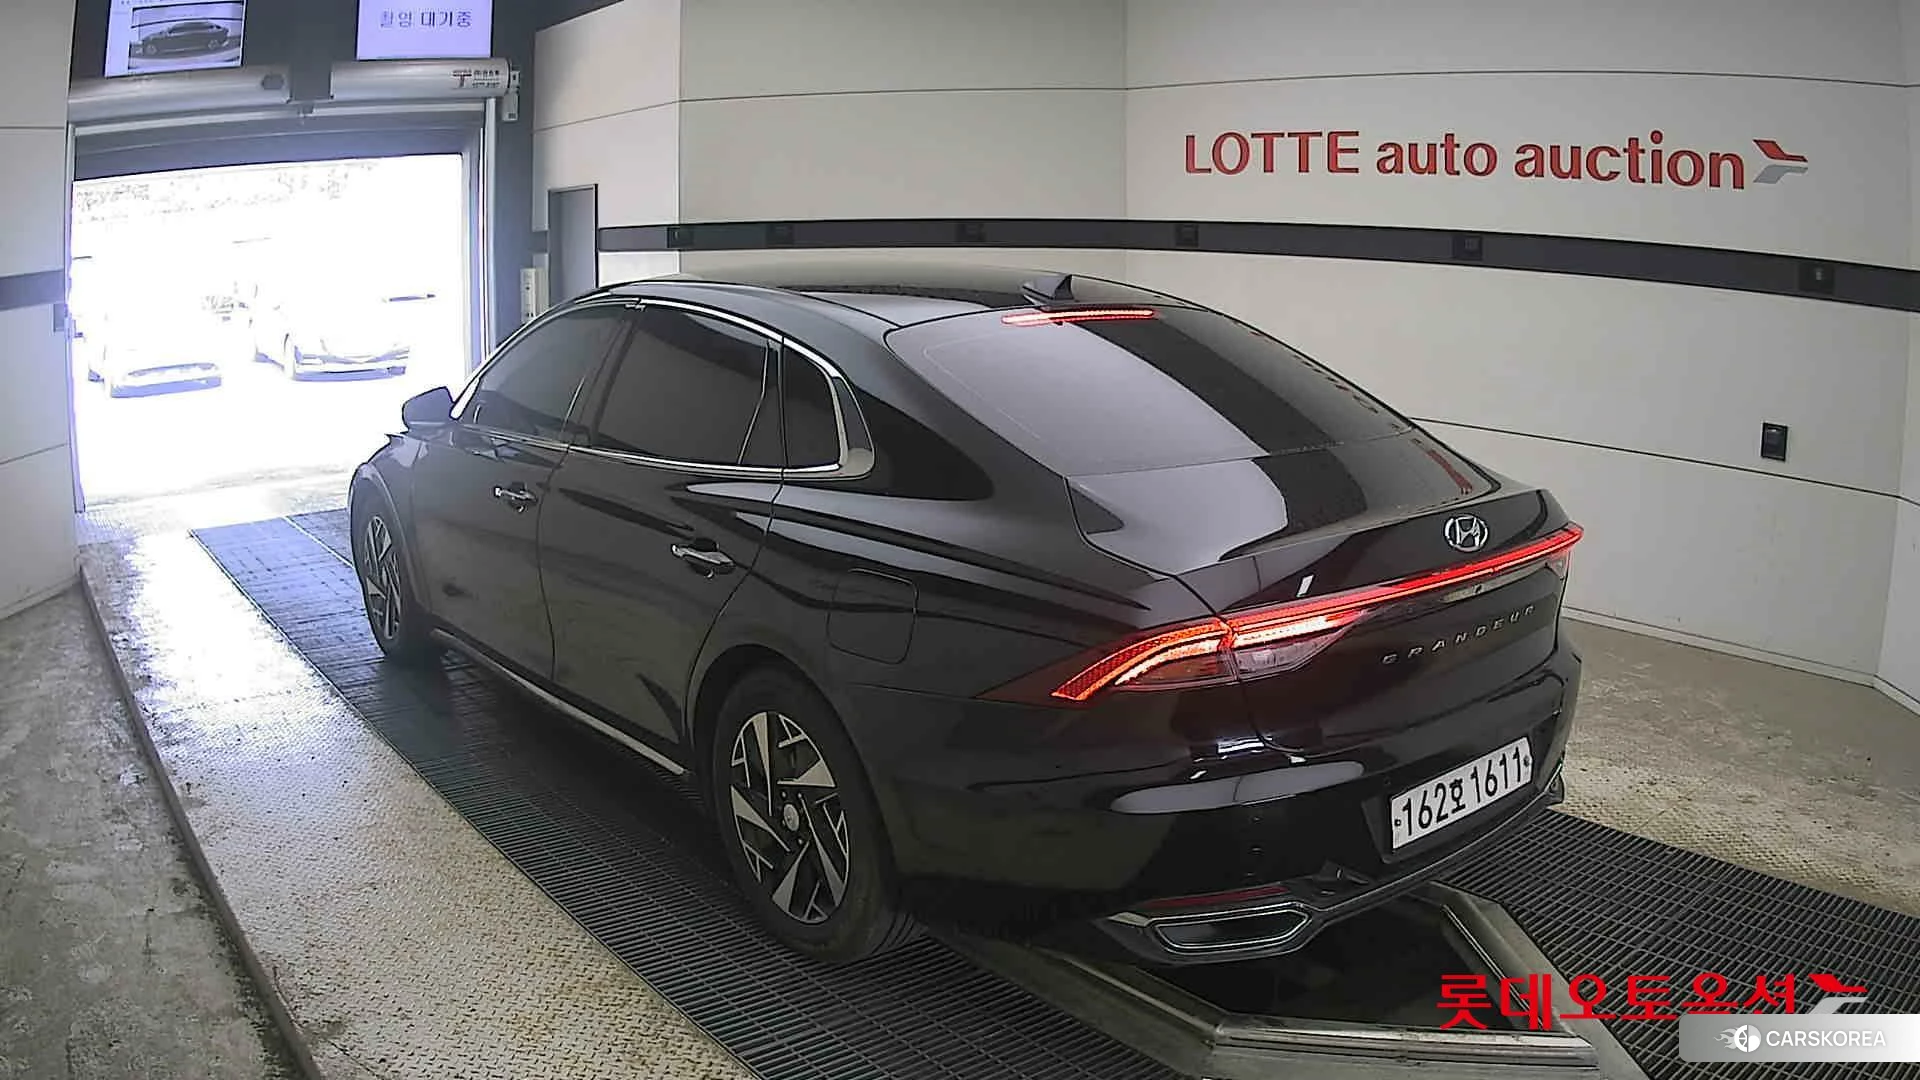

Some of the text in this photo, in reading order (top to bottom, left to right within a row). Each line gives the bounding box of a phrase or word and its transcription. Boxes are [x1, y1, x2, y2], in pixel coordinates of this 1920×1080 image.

[1185, 130, 1746, 190] LOTTE auto auction
[1381, 605, 1535, 664] GRANDEUR
[1470, 746, 1522, 804] 1611
